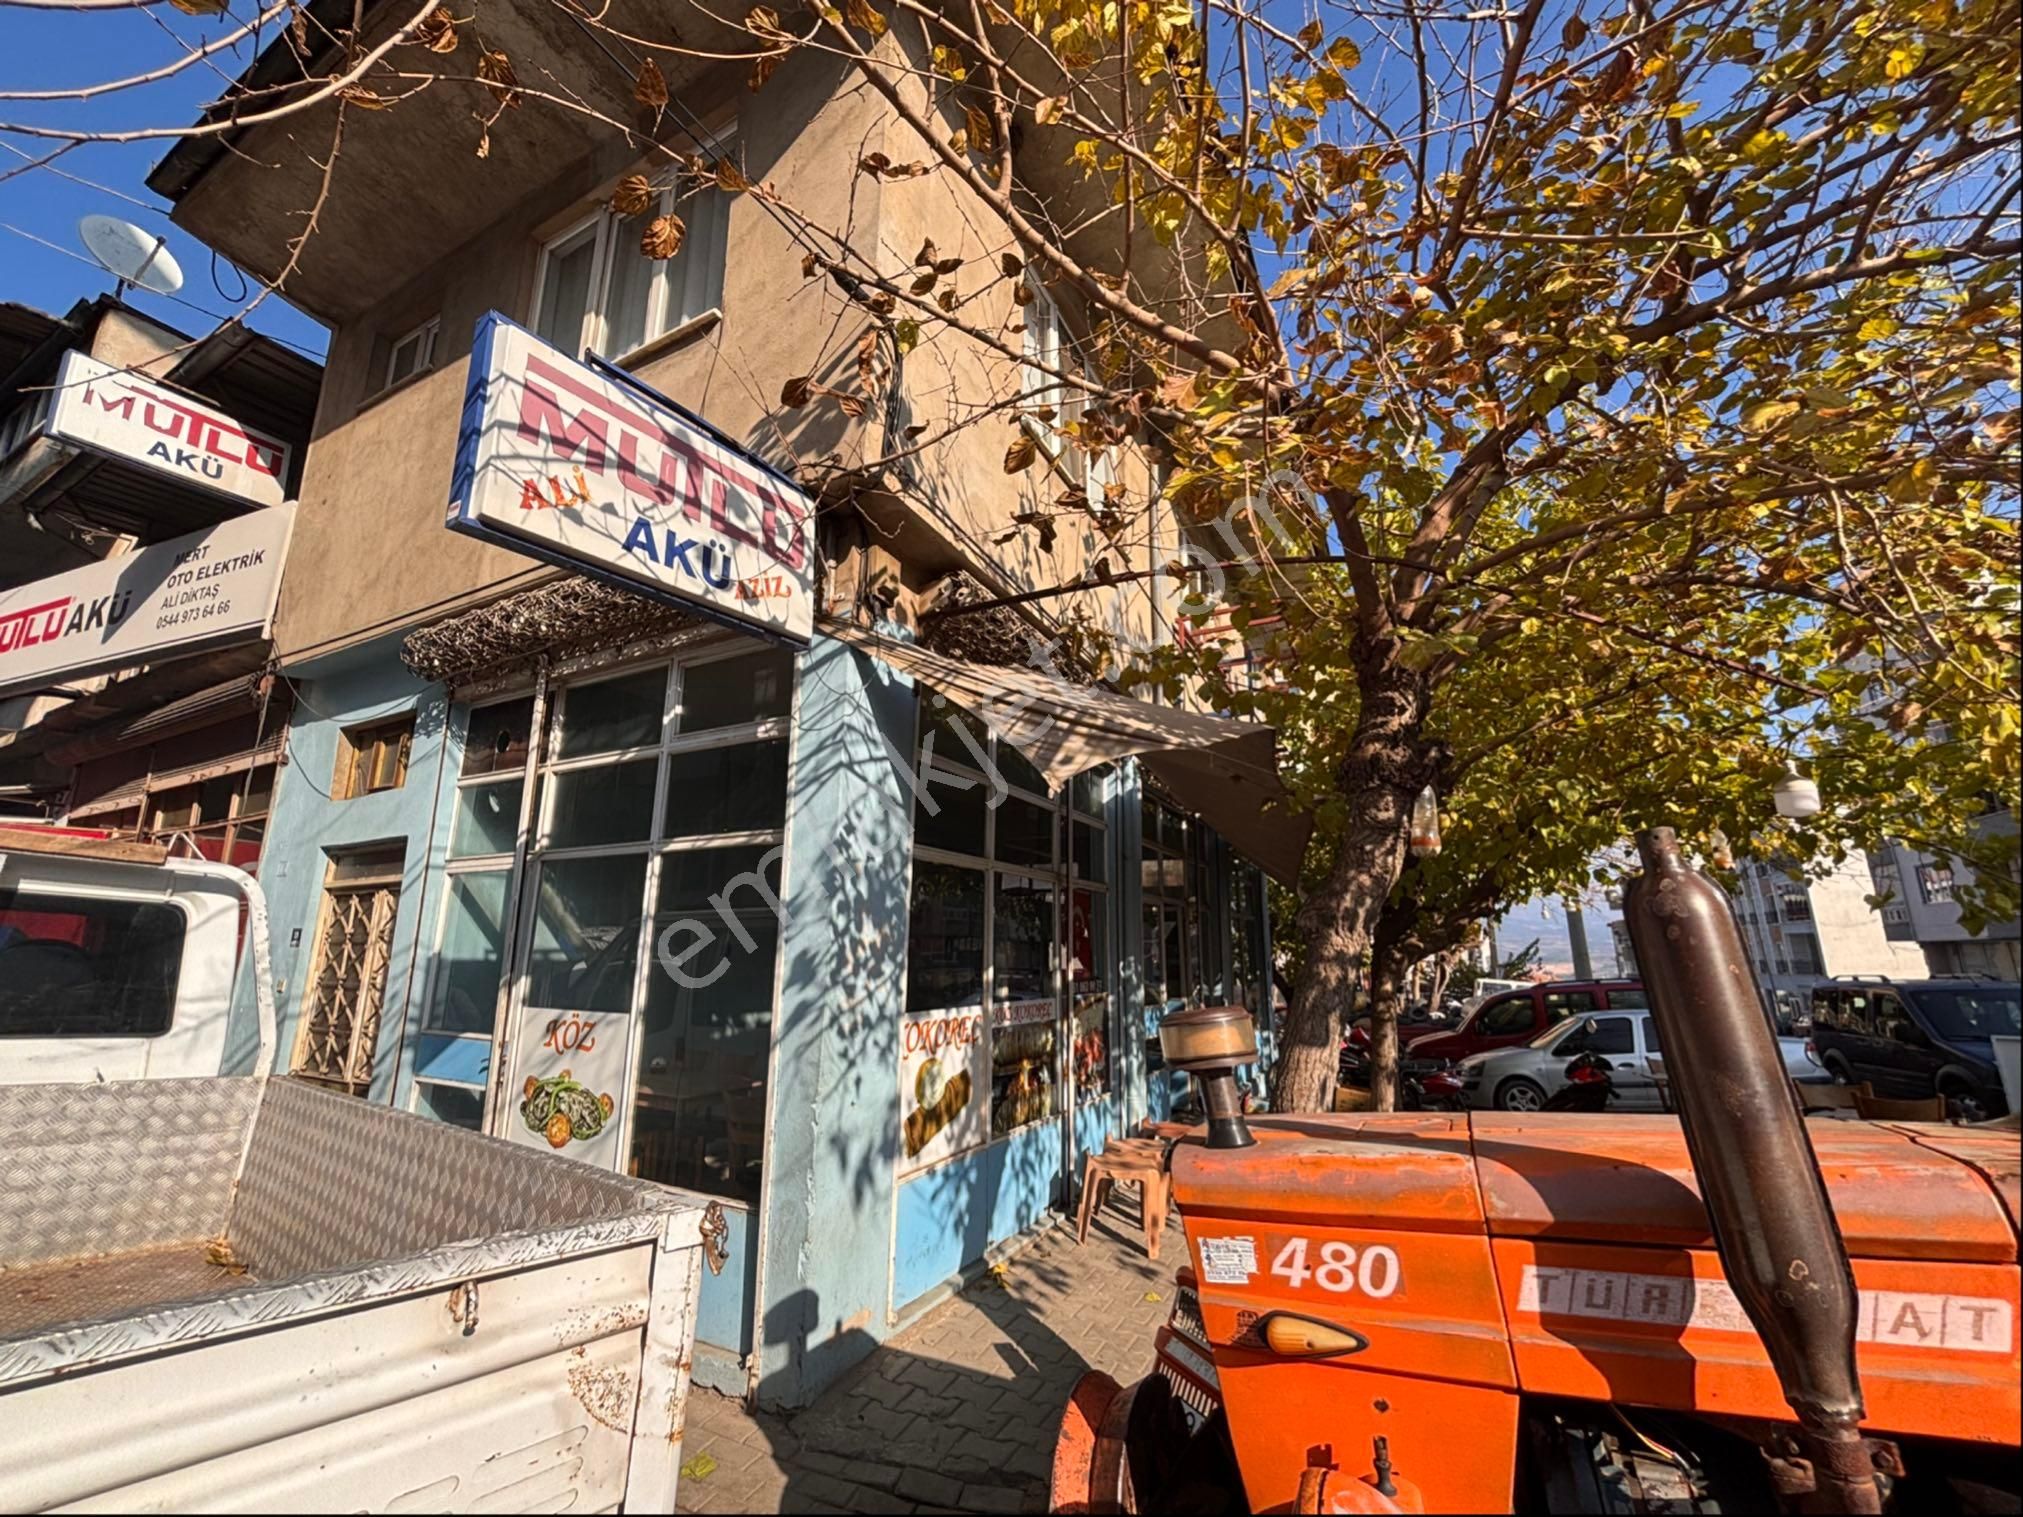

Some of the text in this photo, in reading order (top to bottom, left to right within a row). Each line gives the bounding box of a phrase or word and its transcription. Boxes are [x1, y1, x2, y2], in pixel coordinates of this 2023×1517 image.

[82, 372, 286, 478] MUTLU
[147, 441, 224, 480] AKÜ
[516, 353, 805, 569] MUTLU
[519, 464, 593, 511] ALİ
[167, 549, 265, 589] OTO ELEKTRİK
[173, 545, 210, 568] MERT
[621, 516, 732, 590] AKÜ
[63, 590, 132, 638] AKÜ
[156, 600, 231, 630] 0544 973 64 66
[161, 583, 221, 610] ALİ DİKTAŞ
[544, 1013, 597, 1055] KÖZ
[1271, 1236, 1400, 1299] 480
[1532, 1273, 1998, 1341] TÜR AT
